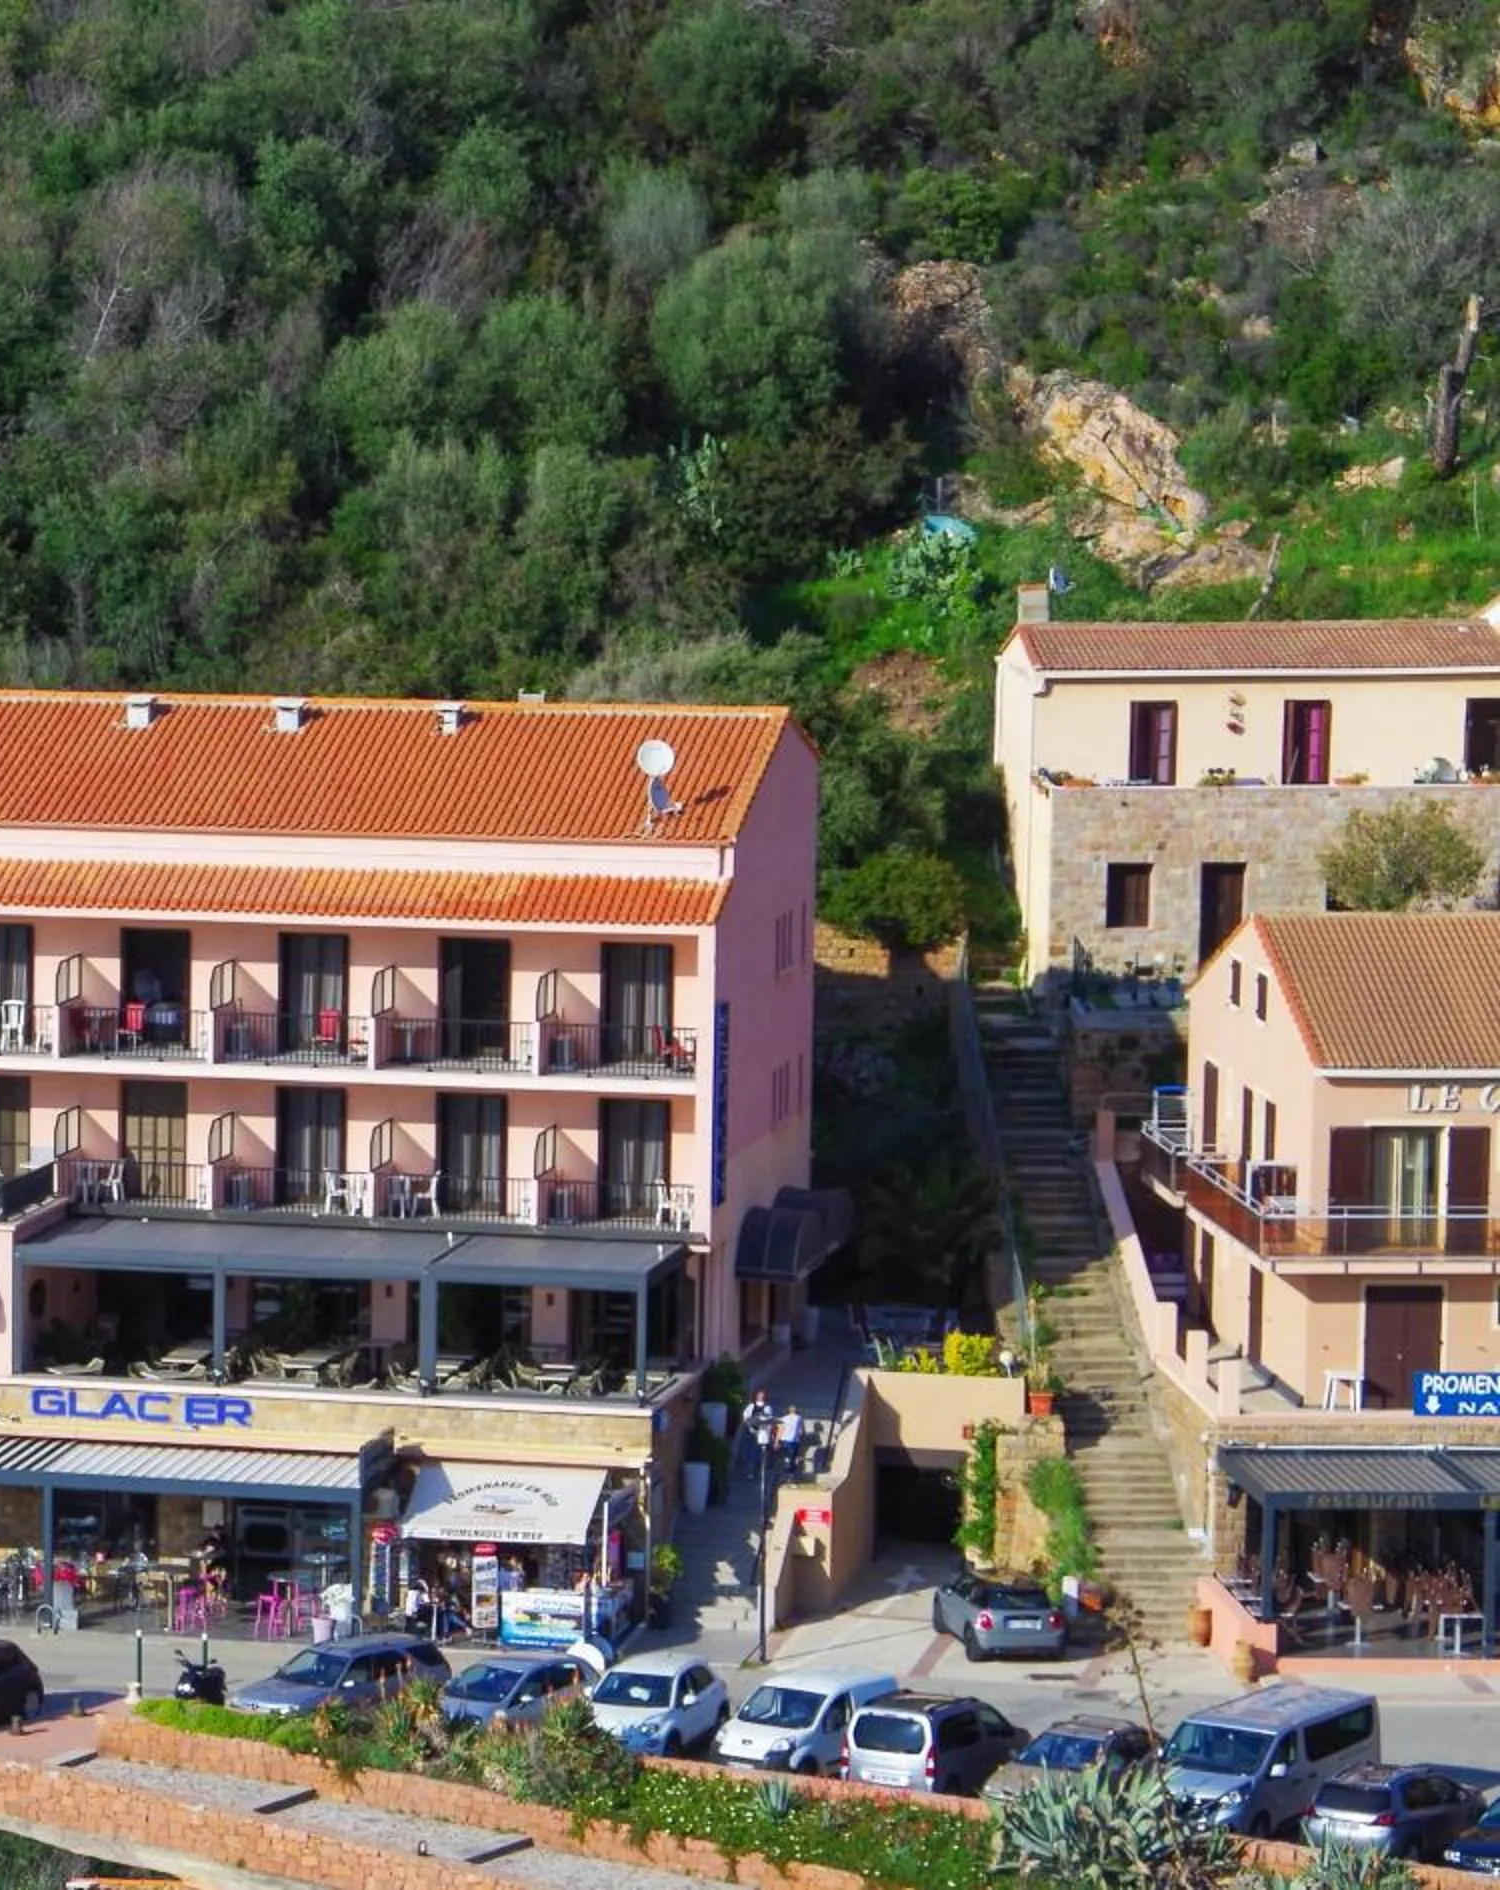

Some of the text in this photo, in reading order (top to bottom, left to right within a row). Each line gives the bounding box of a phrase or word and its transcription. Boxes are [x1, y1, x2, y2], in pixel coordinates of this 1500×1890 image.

[1411, 1084, 1461, 1112] LE
[1458, 1401, 1500, 1414] NA
[1307, 1493, 1437, 1509] restaurant
